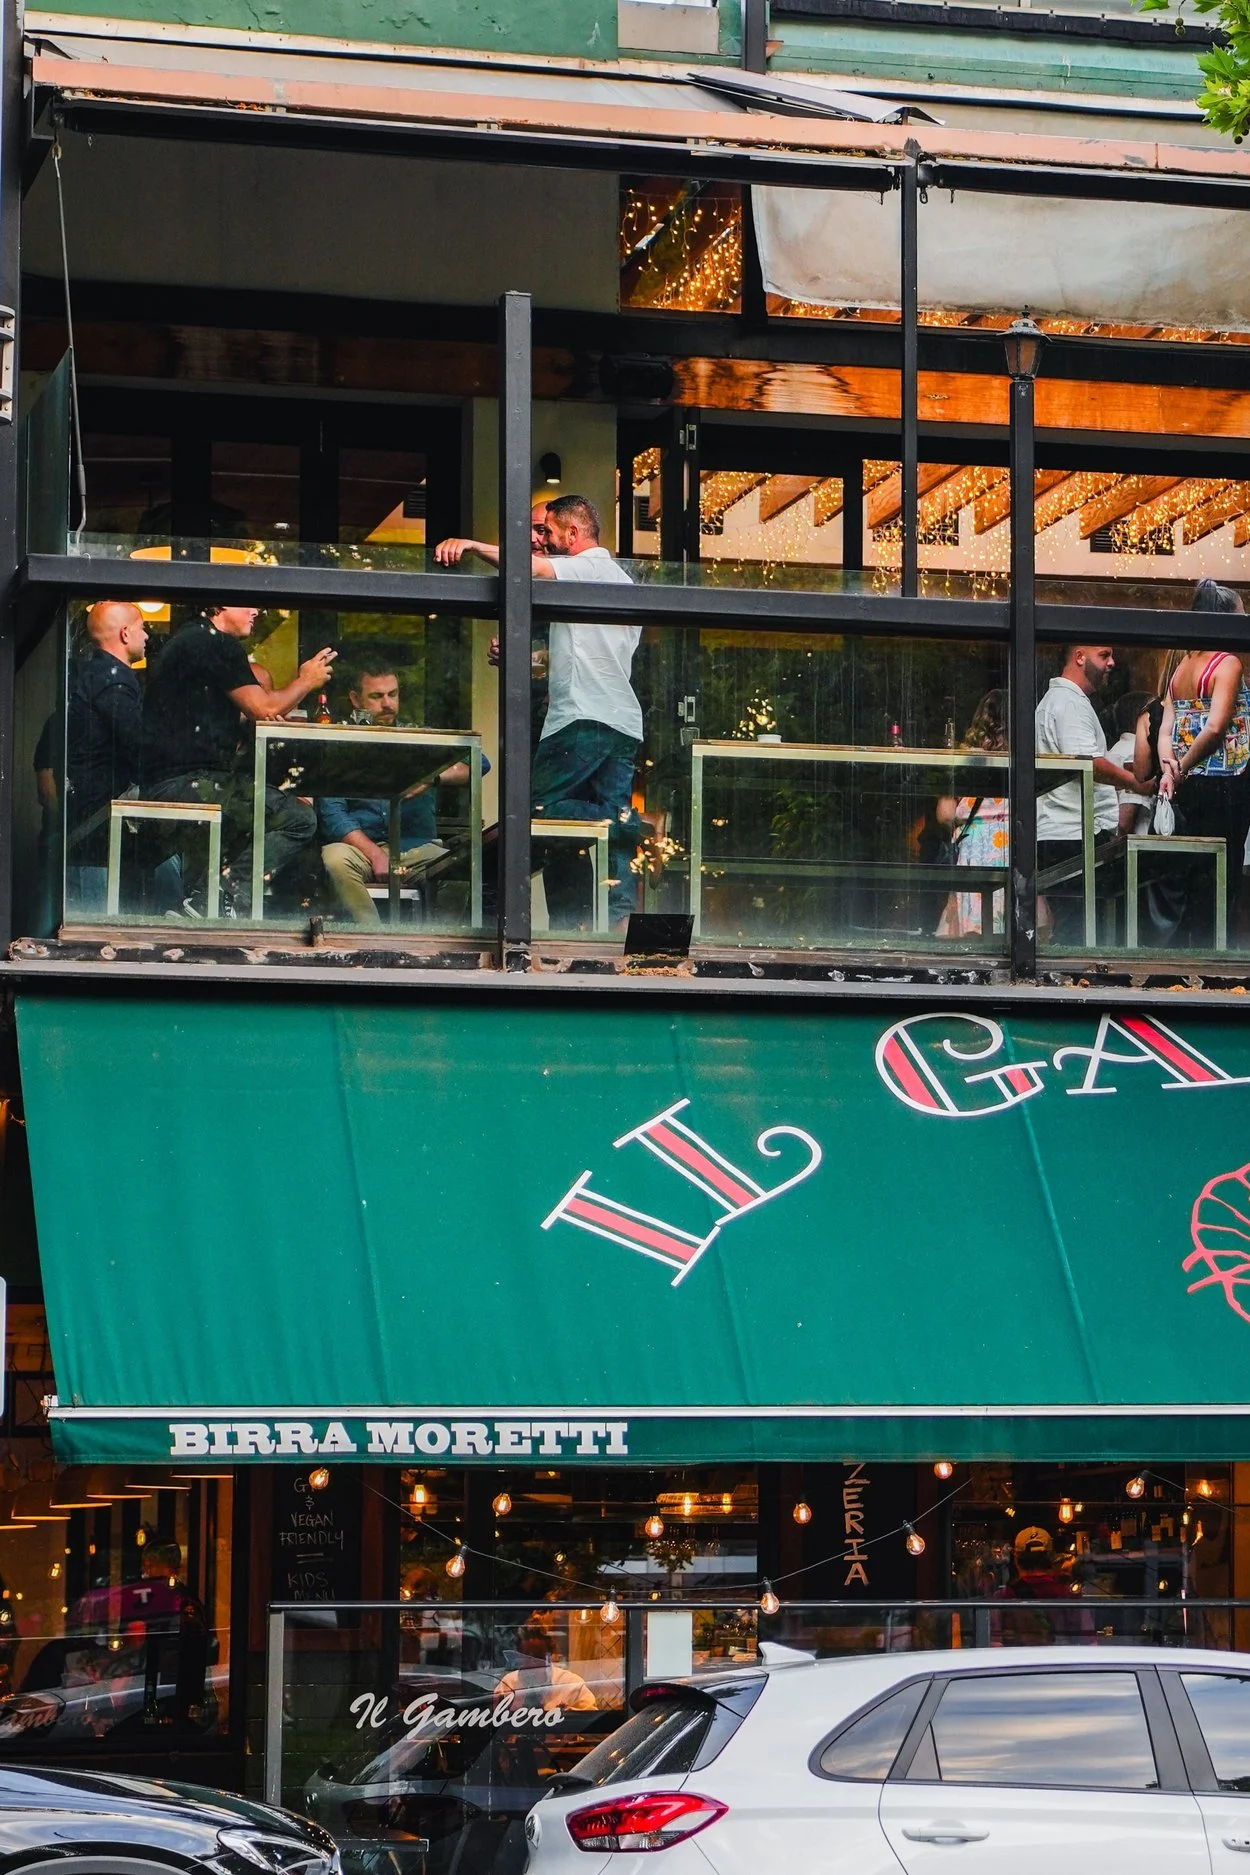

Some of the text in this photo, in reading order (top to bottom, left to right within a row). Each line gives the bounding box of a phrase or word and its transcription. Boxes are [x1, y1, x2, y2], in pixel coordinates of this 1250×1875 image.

[541, 1097, 823, 1287] IL
[169, 1421, 628, 1456] BIRRA MORETTI
[290, 1510, 334, 1527] VEGAN
[279, 1530, 344, 1550] FRIENDLY
[287, 1572, 329, 1589] KIDS
[349, 1692, 565, 1740] Il Gambero
